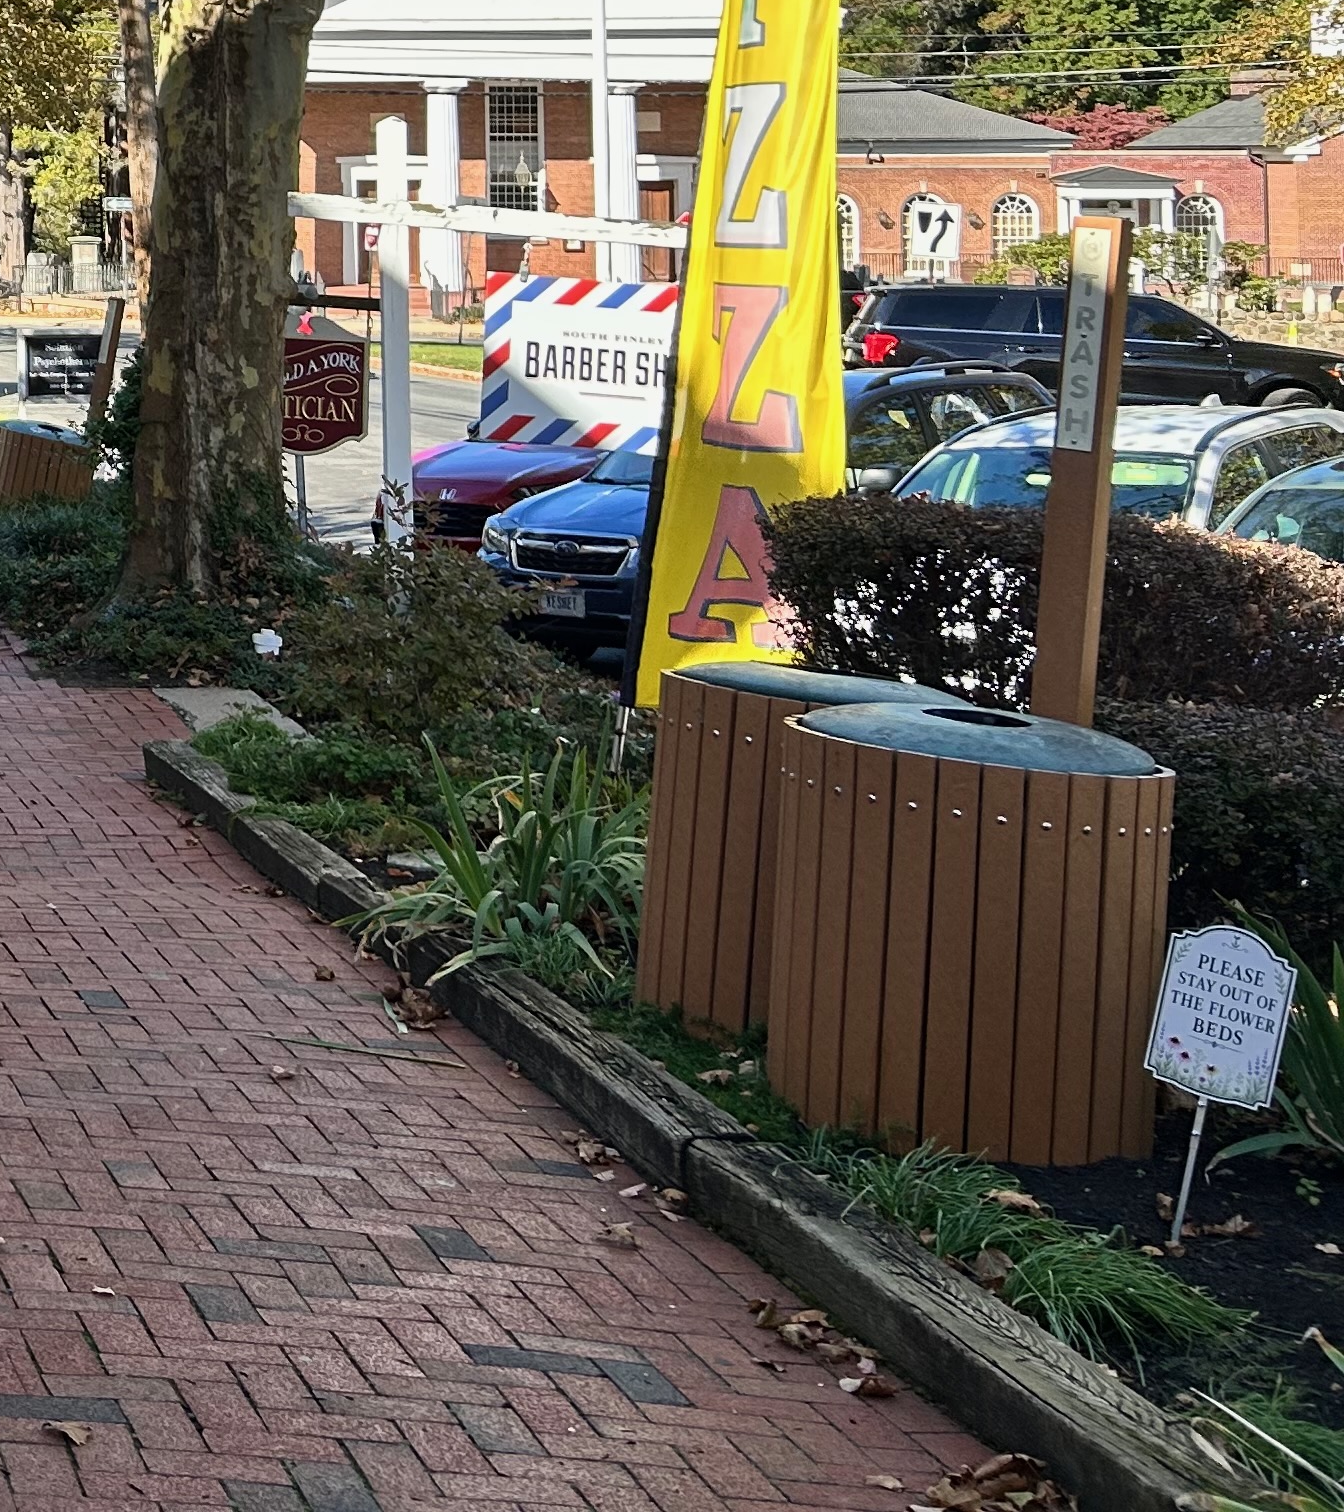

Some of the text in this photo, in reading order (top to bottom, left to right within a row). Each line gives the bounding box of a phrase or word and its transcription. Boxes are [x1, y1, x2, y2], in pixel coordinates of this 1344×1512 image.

[562, 330, 666, 346] SOUTH FINLEY
[1064, 272, 1100, 434] TRASH
[32, 355, 99, 369] Psychotherap
[282, 362, 304, 386] LD
[320, 351, 362, 374] YORK
[525, 340, 627, 386] BARBER
[1198, 952, 1266, 989] PLEASE
[1177, 970, 1278, 1013] STAY OUT OF
[1170, 989, 1276, 1035] THE FLOWER
[1192, 1016, 1244, 1046] BEDS
